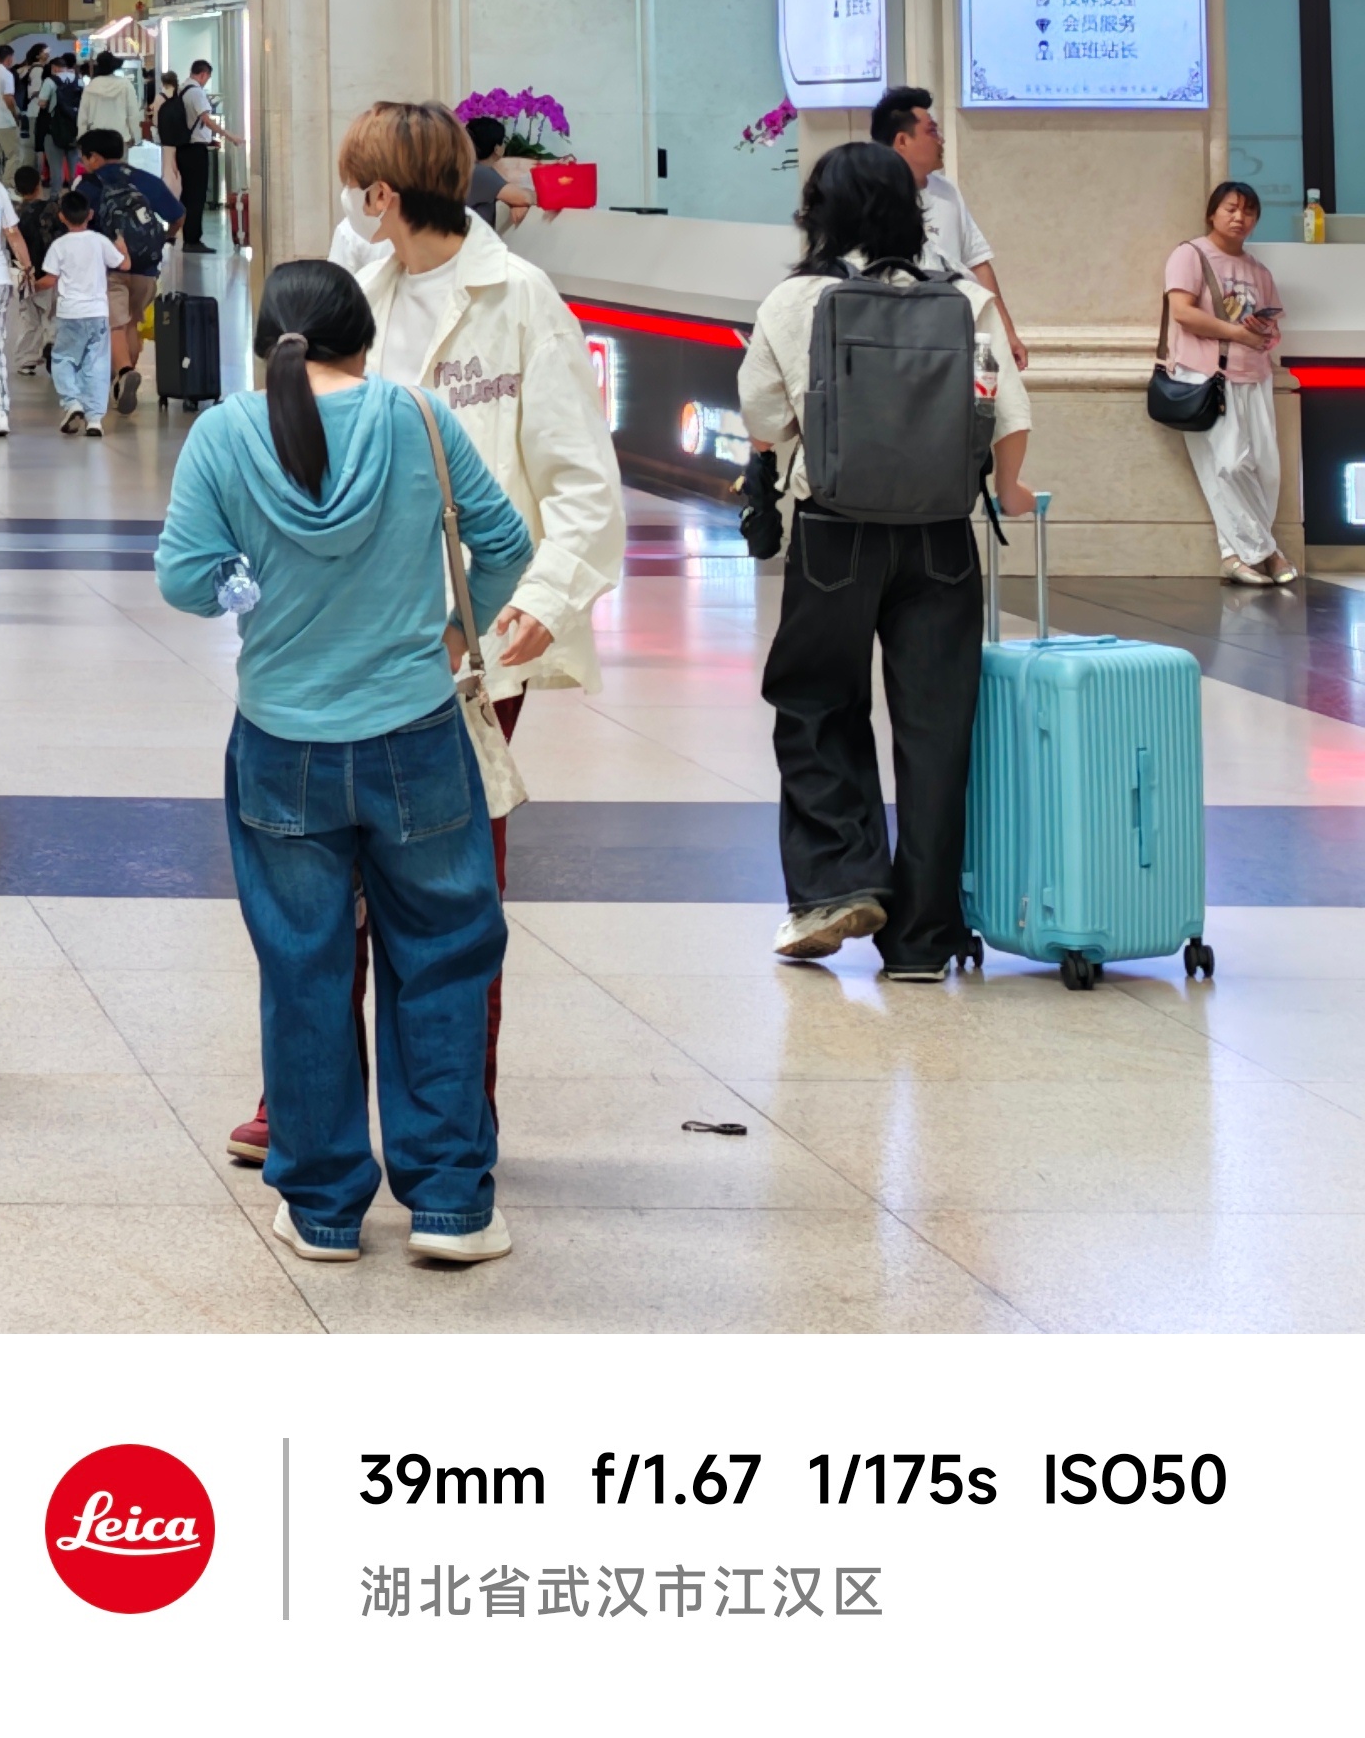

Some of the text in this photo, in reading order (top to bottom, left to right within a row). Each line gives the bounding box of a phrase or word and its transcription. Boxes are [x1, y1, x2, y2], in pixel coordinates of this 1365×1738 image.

[1063, 14, 1136, 33] 会员服务
[1063, 41, 1139, 59] 值班站长
